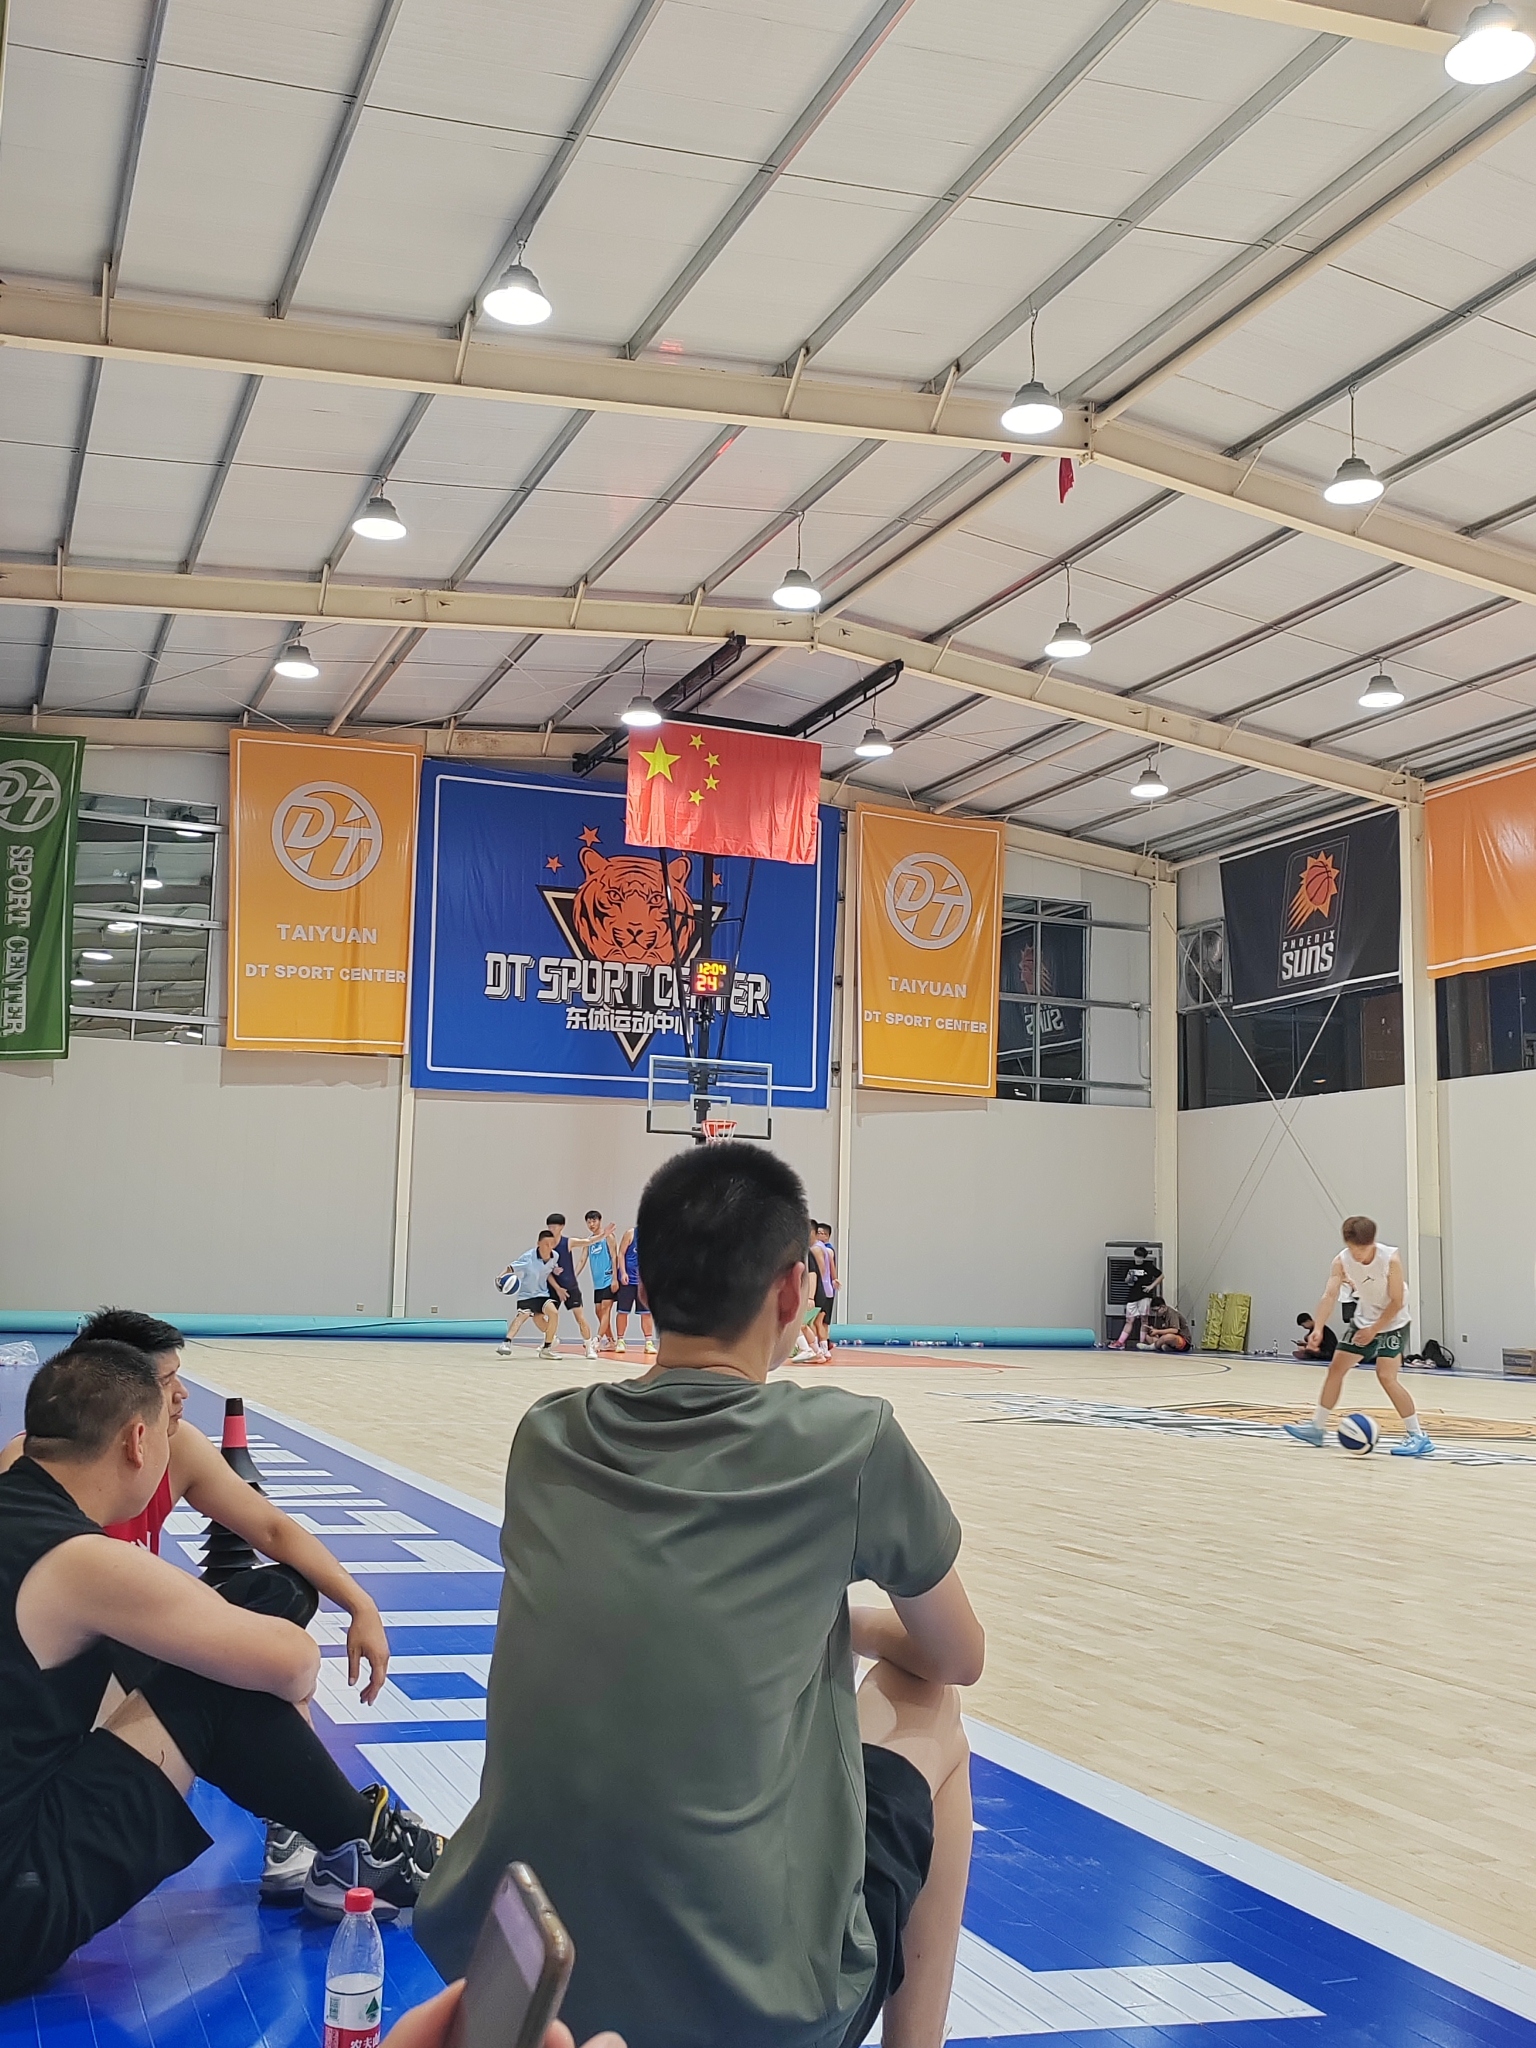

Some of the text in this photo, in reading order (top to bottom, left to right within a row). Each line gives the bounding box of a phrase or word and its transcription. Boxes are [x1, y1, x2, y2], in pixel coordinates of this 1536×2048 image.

[0, 845, 35, 1038] SPORT CENTER
[276, 923, 378, 944] TAIYUAN
[1282, 929, 1335, 951] PHOENIX
[1281, 941, 1335, 981] SUNS
[245, 963, 406, 984] DT SPORT CENTER
[696, 974, 718, 992] 24
[483, 952, 771, 1020] DT SPORT CEER
[888, 975, 968, 999] TAIYUAN
[863, 1009, 988, 1034] DT SPORT CENTER
